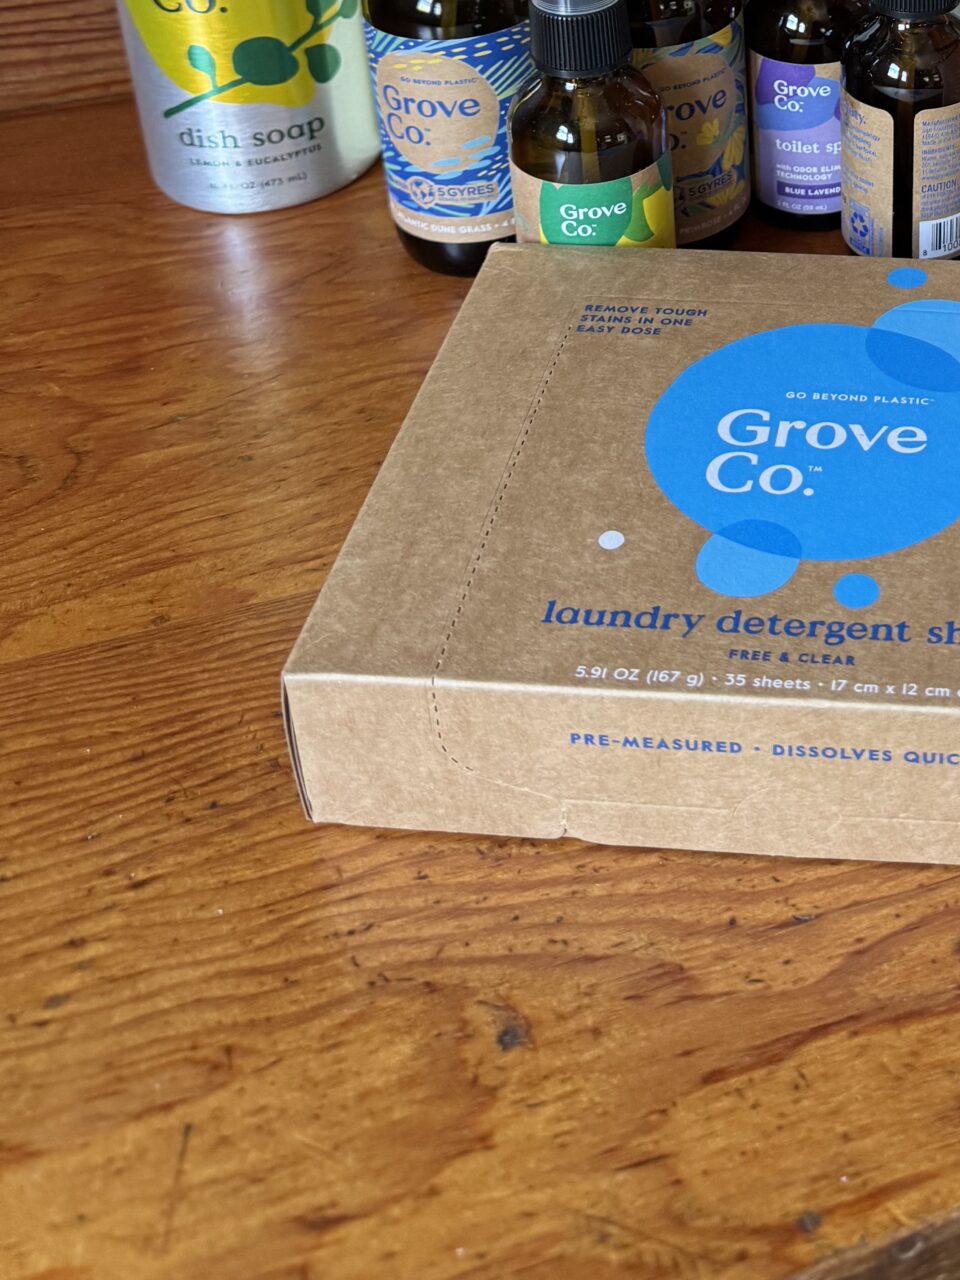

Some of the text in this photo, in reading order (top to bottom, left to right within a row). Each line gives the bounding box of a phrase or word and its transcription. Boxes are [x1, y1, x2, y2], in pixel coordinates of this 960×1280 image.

[773, 79, 831, 97] Grove
[382, 84, 481, 118] Grove
[179, 116, 326, 149] dish soap
[190, 157, 230, 167] LEMON
[247, 142, 323, 167] EUCALYPTUS
[775, 138, 821, 154] toilet
[776, 170, 833, 181] TECHNOLOGY
[793, 165, 819, 173] ODOR
[784, 186, 841, 196] BLUE LAVEND
[559, 202, 627, 220] Grove
[459, 223, 493, 234] GRASS
[584, 304, 708, 317] REMOVE TOUGH
[580, 314, 694, 326] STAINS IN ONE
[576, 324, 663, 336] EASY DOSE
[785, 391, 807, 399] GO
[812, 392, 868, 403] BEYOND
[717, 408, 929, 454] Grove
[540, 599, 706, 639] laundry
[716, 609, 911, 647] detergent
[728, 648, 856, 666] FREE & CLEAR
[575, 665, 607, 680] 5.91
[613, 667, 641, 682] OZ
[646, 669, 681, 685] (167
[686, 671, 705, 688] g)
[724, 673, 747, 687] 35
[752, 675, 811, 691] sheets
[831, 679, 848, 692] 17
[853, 682, 879, 694] cm
[885, 685, 896, 695] x
[902, 683, 918, 696] 12
[925, 686, 950, 698] cm
[569, 732, 743, 755] PRE-MEASURED
[772, 743, 893, 763] DISSOLVES
